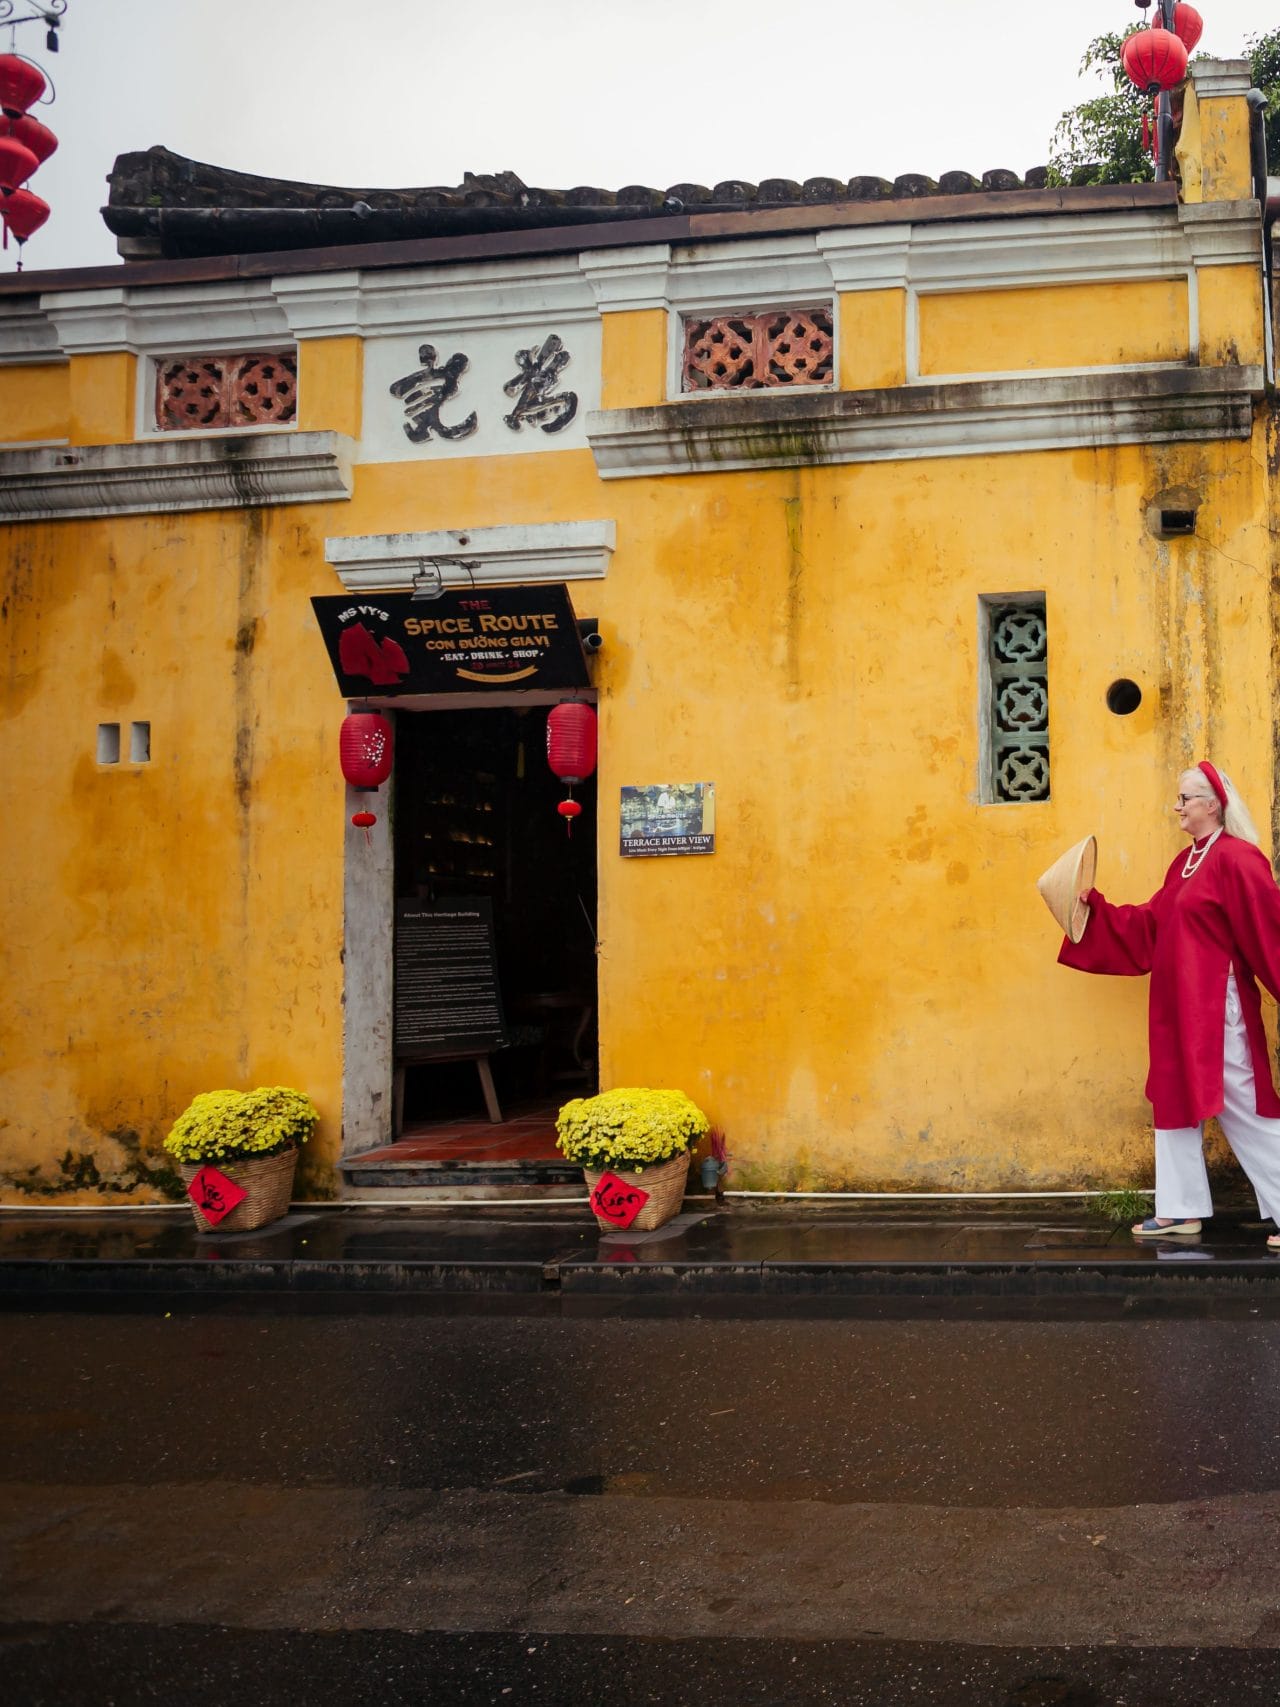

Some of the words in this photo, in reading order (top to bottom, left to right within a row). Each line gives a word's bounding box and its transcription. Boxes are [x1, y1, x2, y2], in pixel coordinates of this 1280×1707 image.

[458, 600, 491, 611] THE
[337, 607, 358, 623] MS
[358, 605, 390, 622] VY'S
[403, 617, 474, 636] SPICE
[478, 614, 559, 632] ROUTE
[425, 640, 456, 650] CON
[470, 651, 504, 660] DRINK
[512, 649, 539, 658] SHOP
[623, 838, 660, 847] TERRACE
[662, 837, 687, 845] RIVER
[689, 835, 711, 844] VIEW
